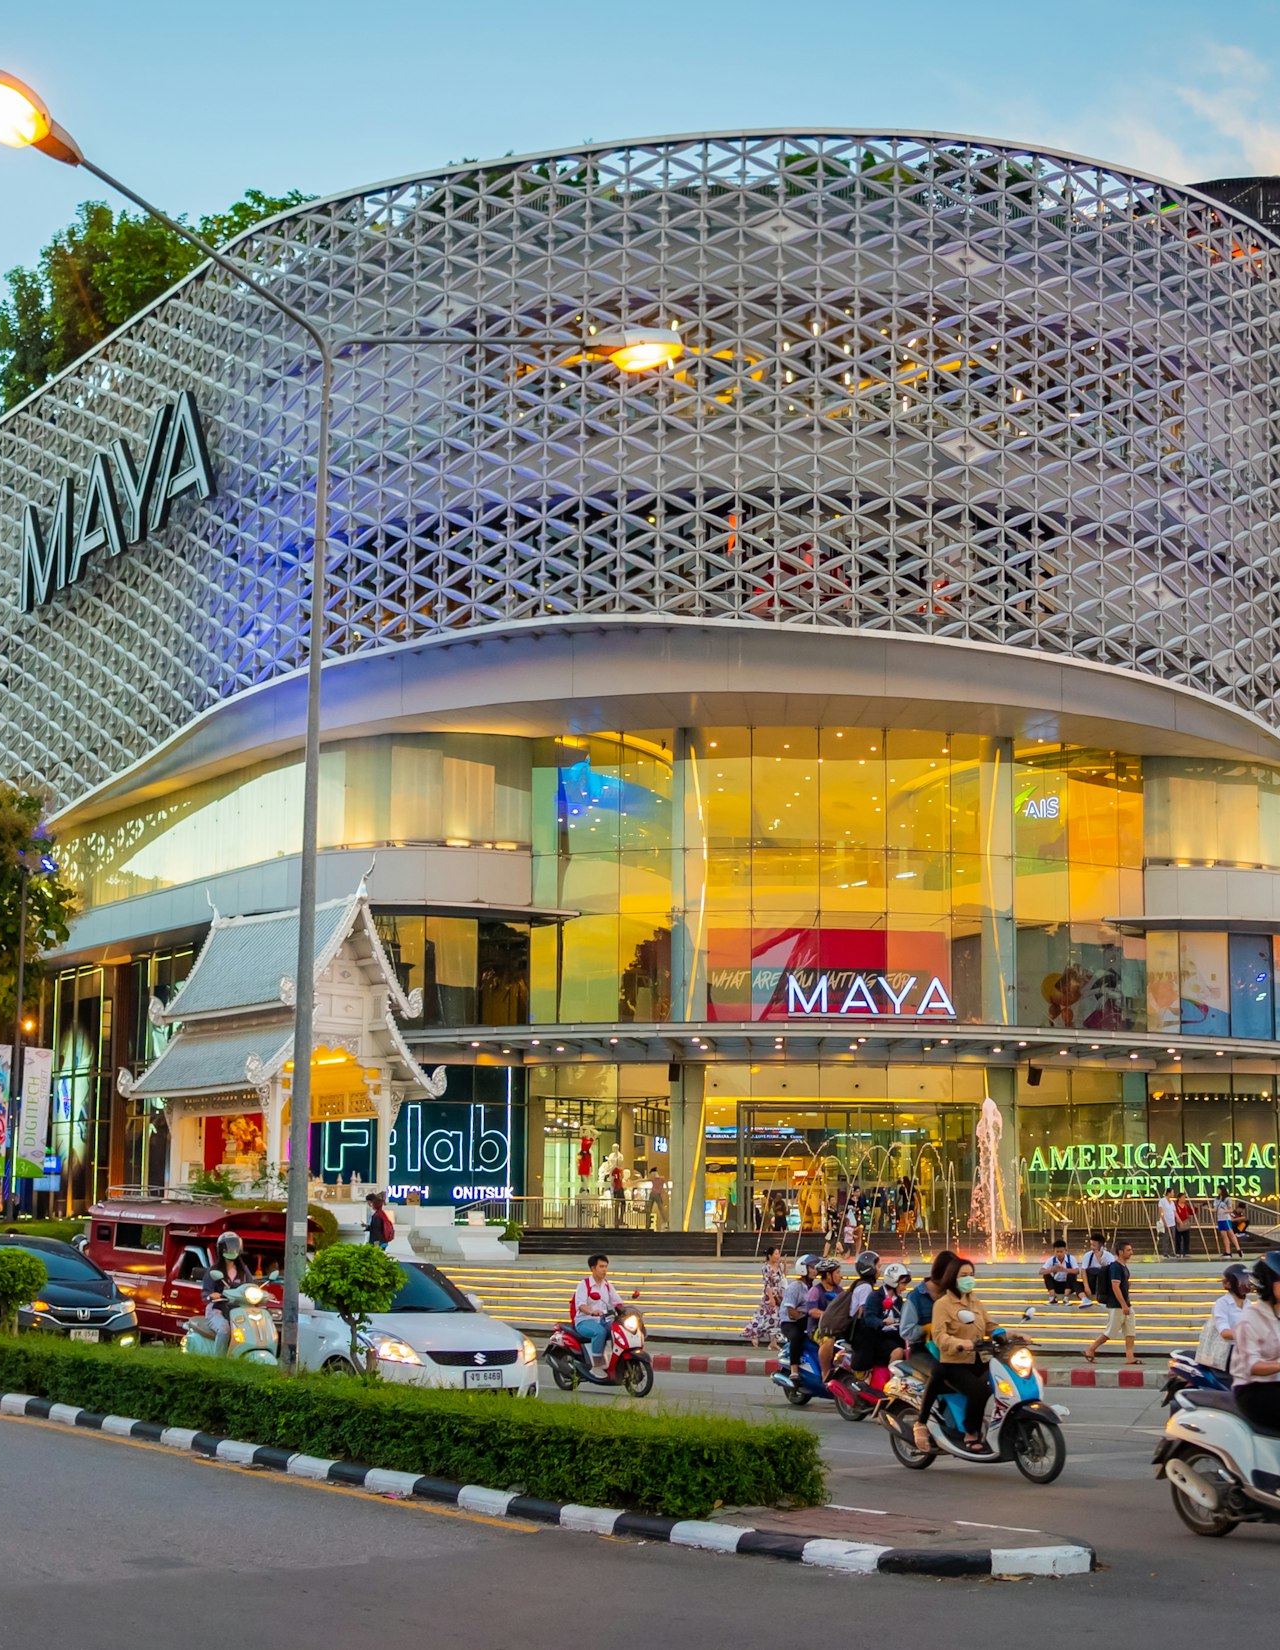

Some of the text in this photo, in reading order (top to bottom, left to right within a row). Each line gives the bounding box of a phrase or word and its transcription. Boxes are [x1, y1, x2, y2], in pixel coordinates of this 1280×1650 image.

[20, 389, 216, 614] MAYA
[1025, 796, 1059, 818] AIS
[710, 969, 751, 992] WHAT
[752, 970, 780, 990] ARE
[787, 974, 957, 1015] MAYA
[23, 1076, 41, 1147] DIGITECH
[1028, 1143, 1213, 1171] AMERICAN
[1086, 1175, 1262, 1198] OUTFITTERS
